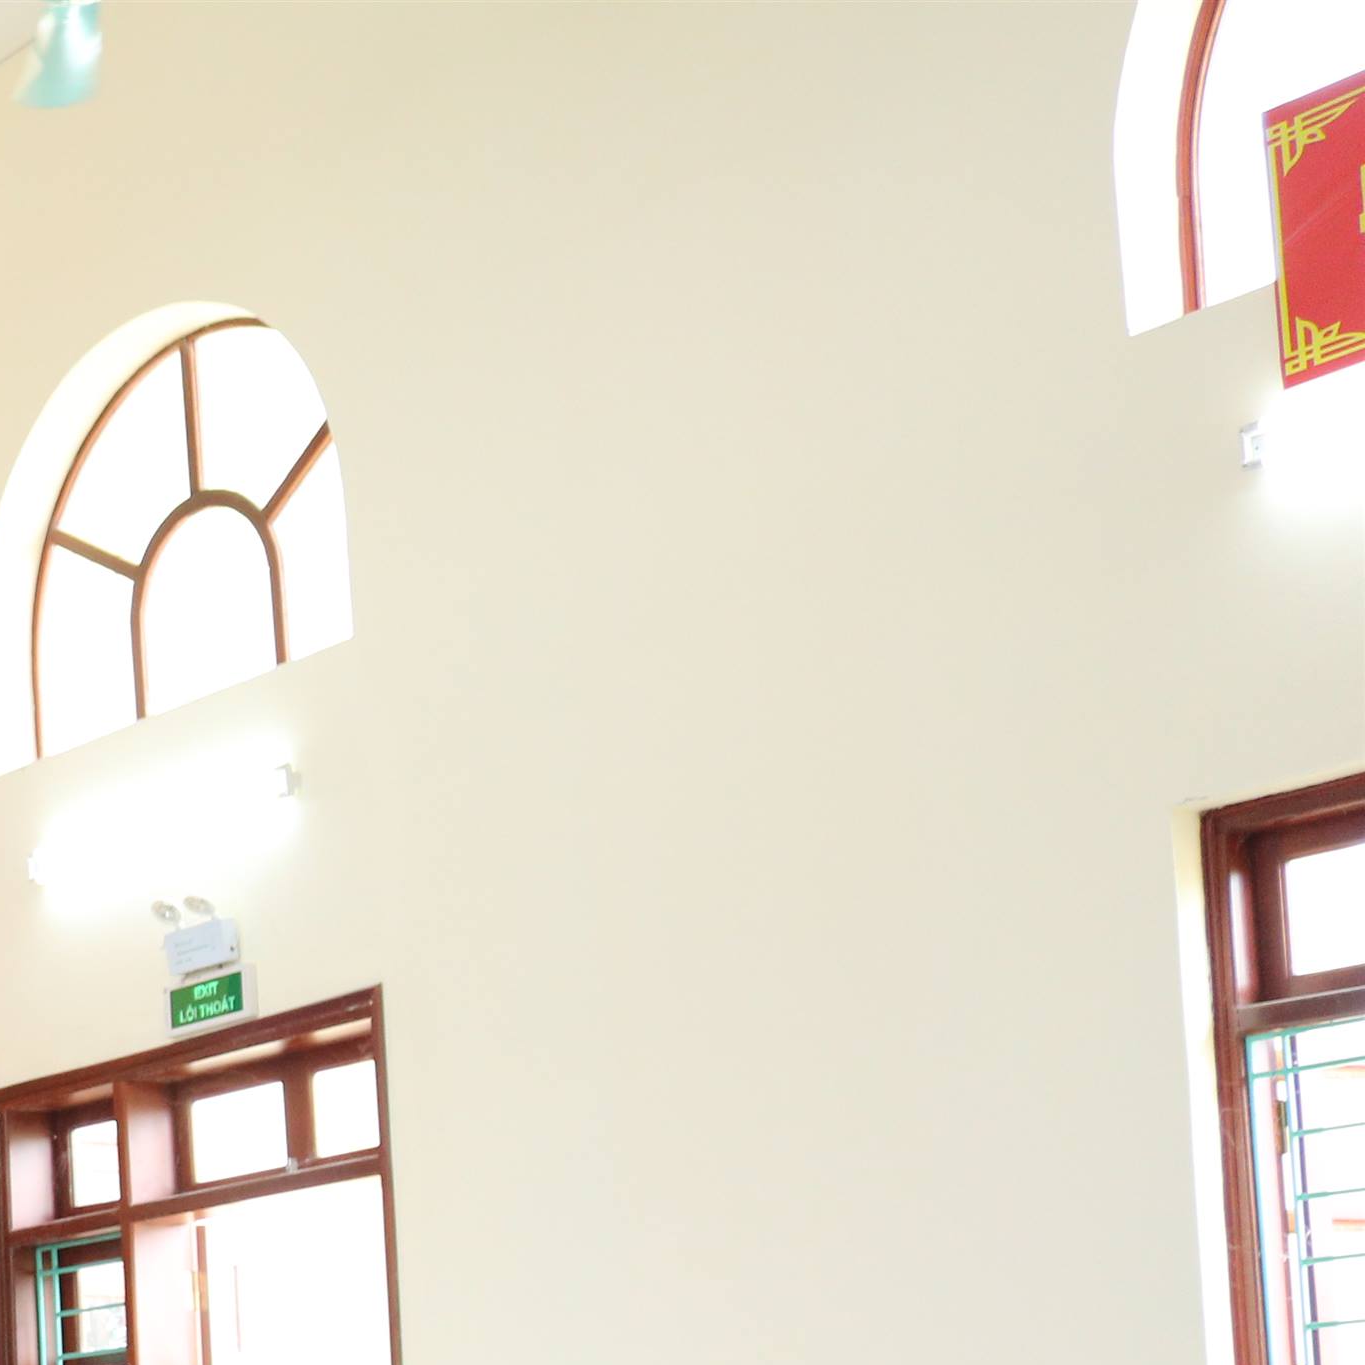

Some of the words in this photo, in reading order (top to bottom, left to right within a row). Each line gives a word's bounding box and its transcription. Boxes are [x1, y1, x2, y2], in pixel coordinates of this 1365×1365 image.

[193, 980, 219, 1001] EXIT
[178, 1003, 198, 1023] LỐI
[199, 994, 236, 1018] THOÁT
